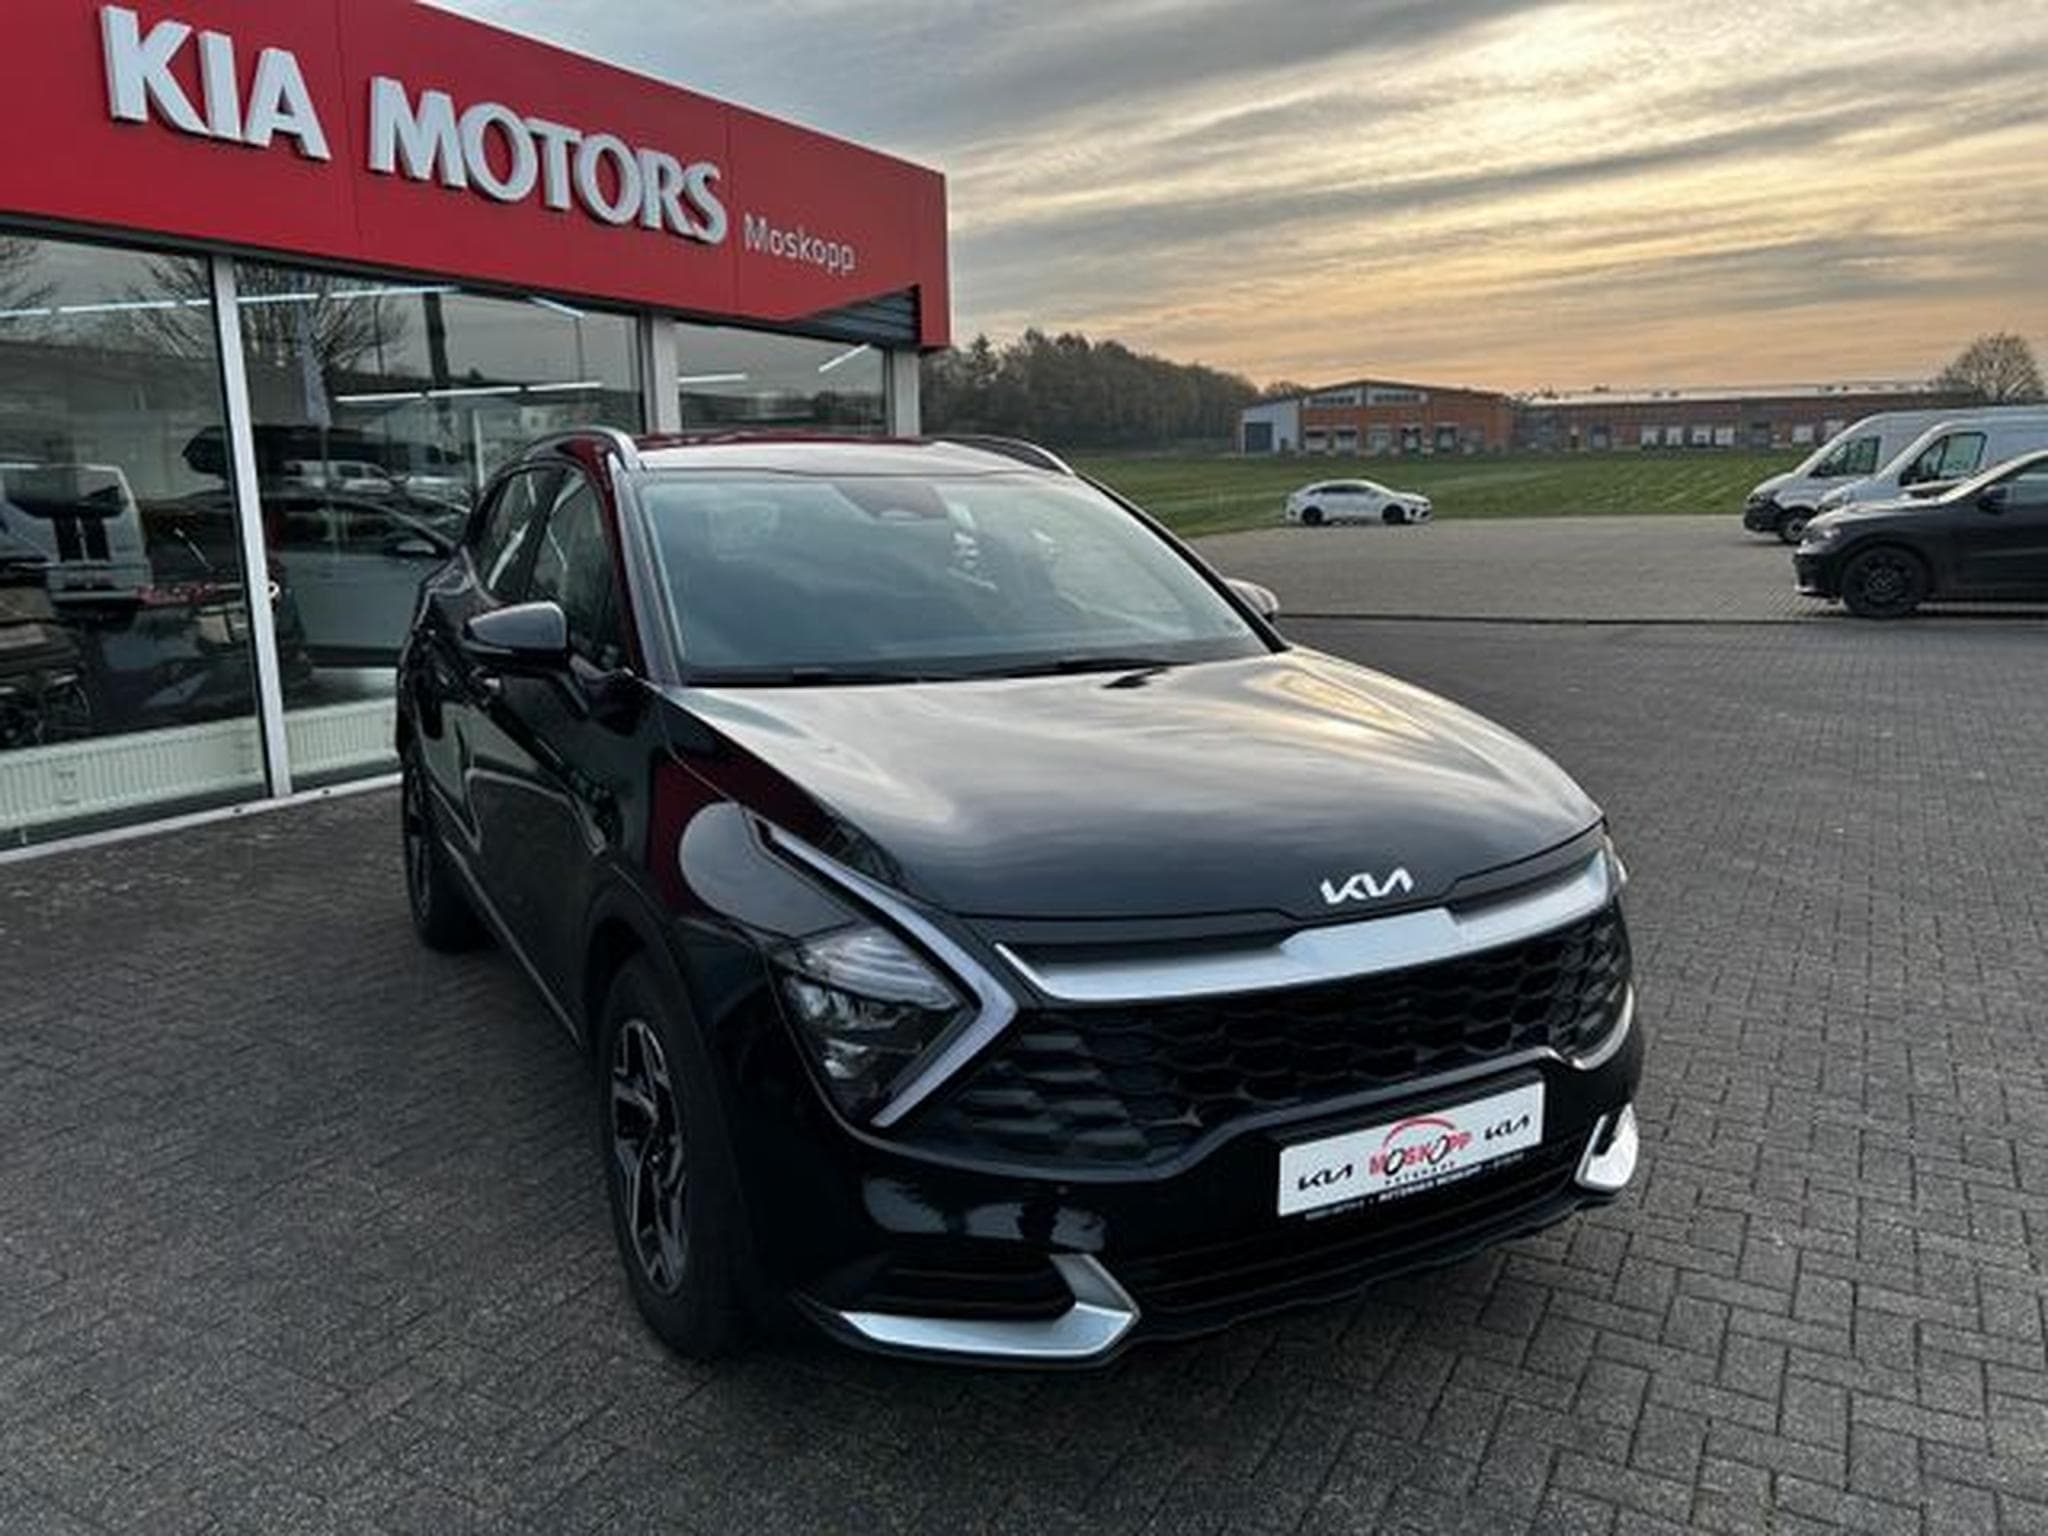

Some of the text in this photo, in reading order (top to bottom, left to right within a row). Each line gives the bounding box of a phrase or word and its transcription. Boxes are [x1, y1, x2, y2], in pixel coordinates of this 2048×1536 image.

[101, 5, 727, 244] KIA MOTORS
[744, 212, 856, 276] Moskopp
[1320, 866, 1414, 904] KIA
[1297, 1163, 1353, 1191] KIA
[1485, 1115, 1530, 1140] KIA
